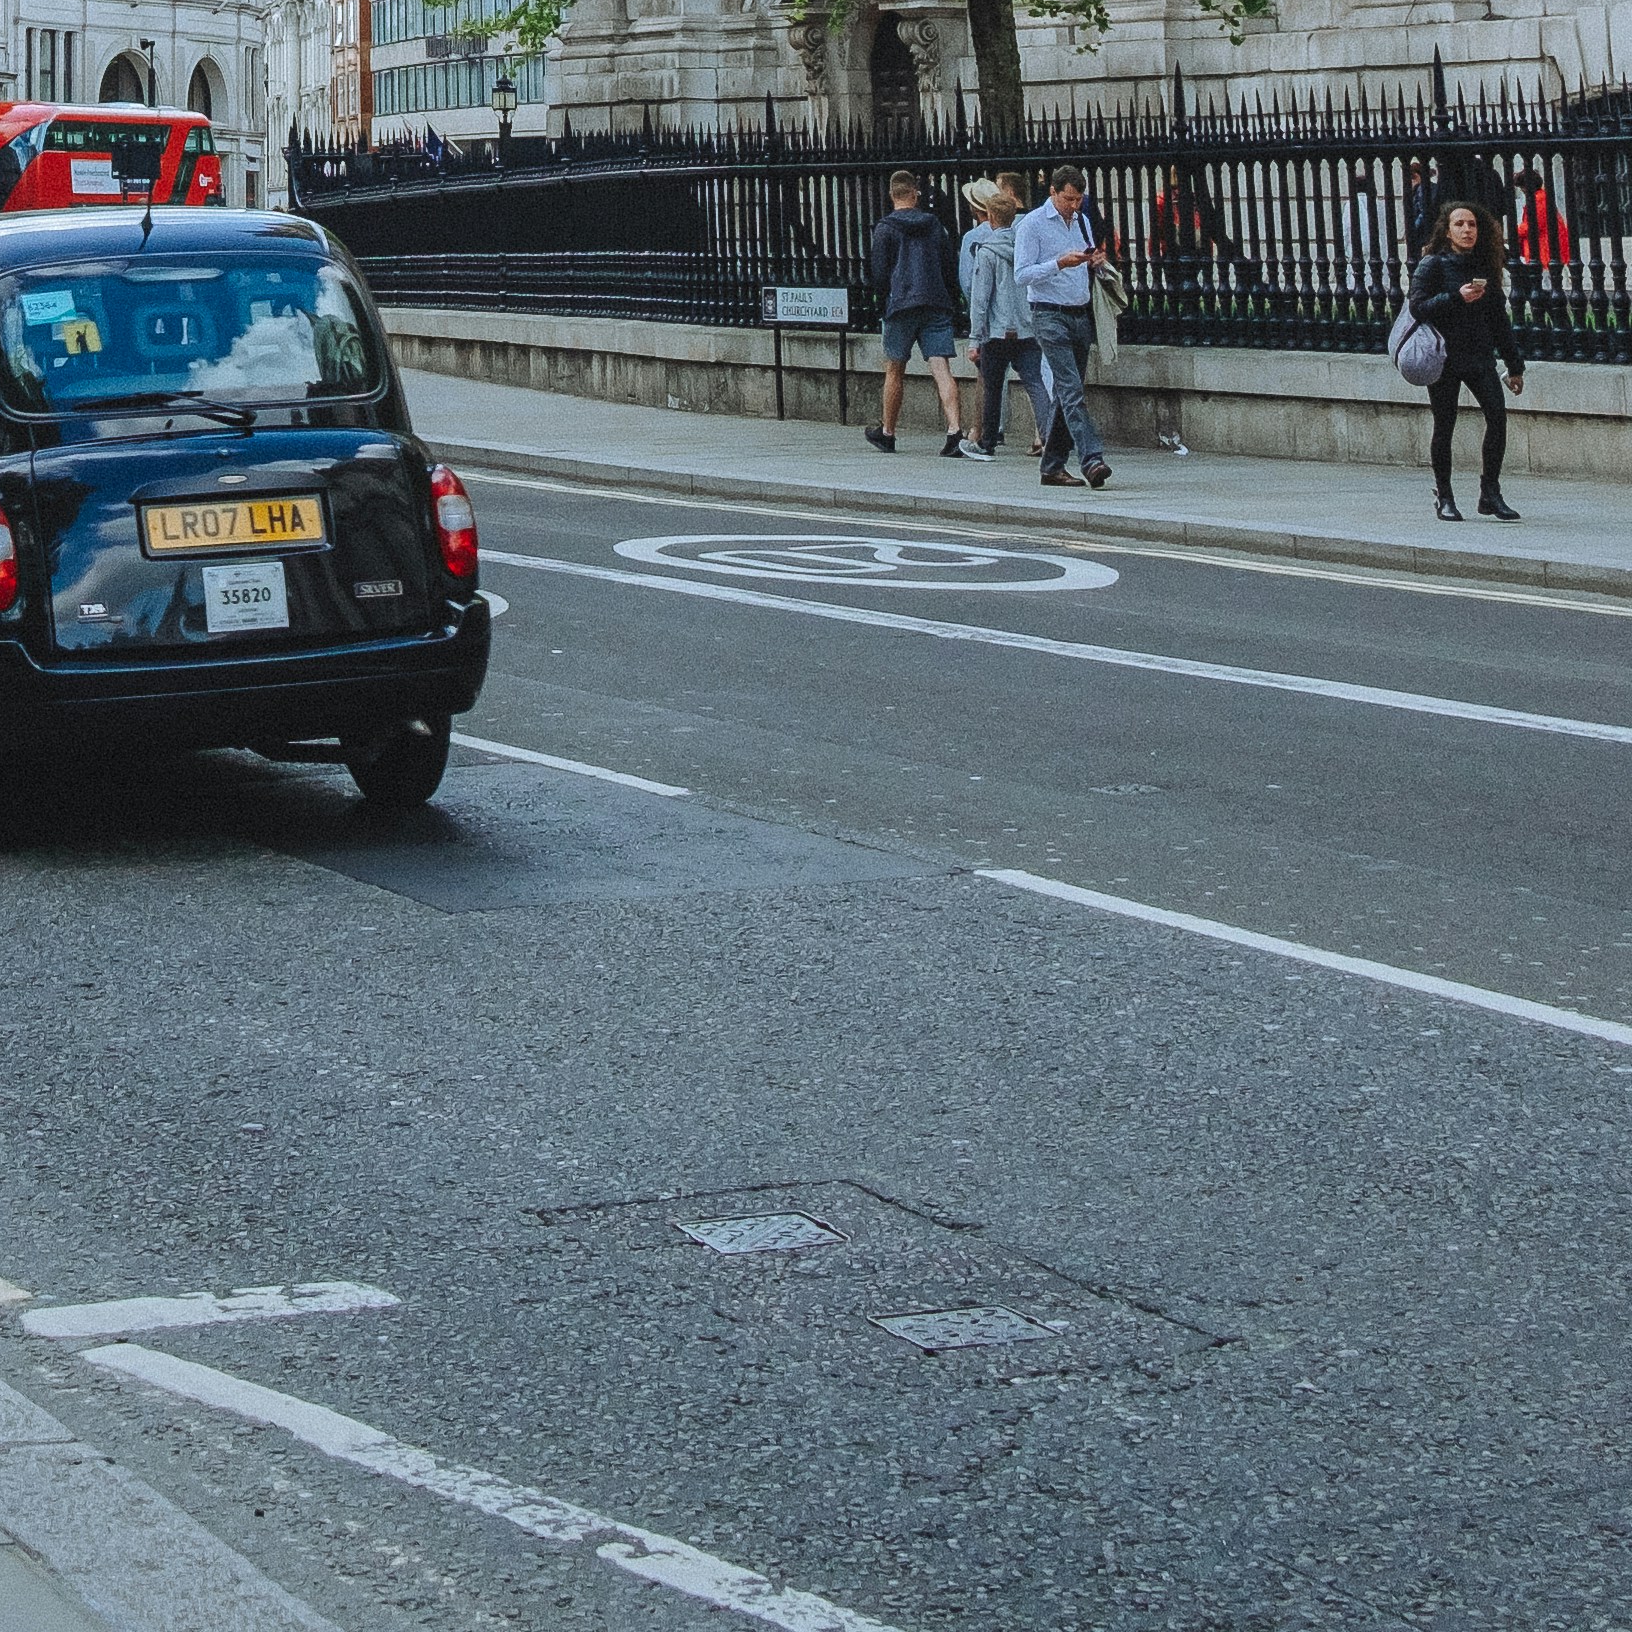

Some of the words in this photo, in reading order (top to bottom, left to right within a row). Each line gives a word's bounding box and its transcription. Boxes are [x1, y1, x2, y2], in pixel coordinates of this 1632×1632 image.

[160, 507, 238, 540] LR07
[248, 503, 306, 534] LHA
[221, 587, 271, 605] 35820
